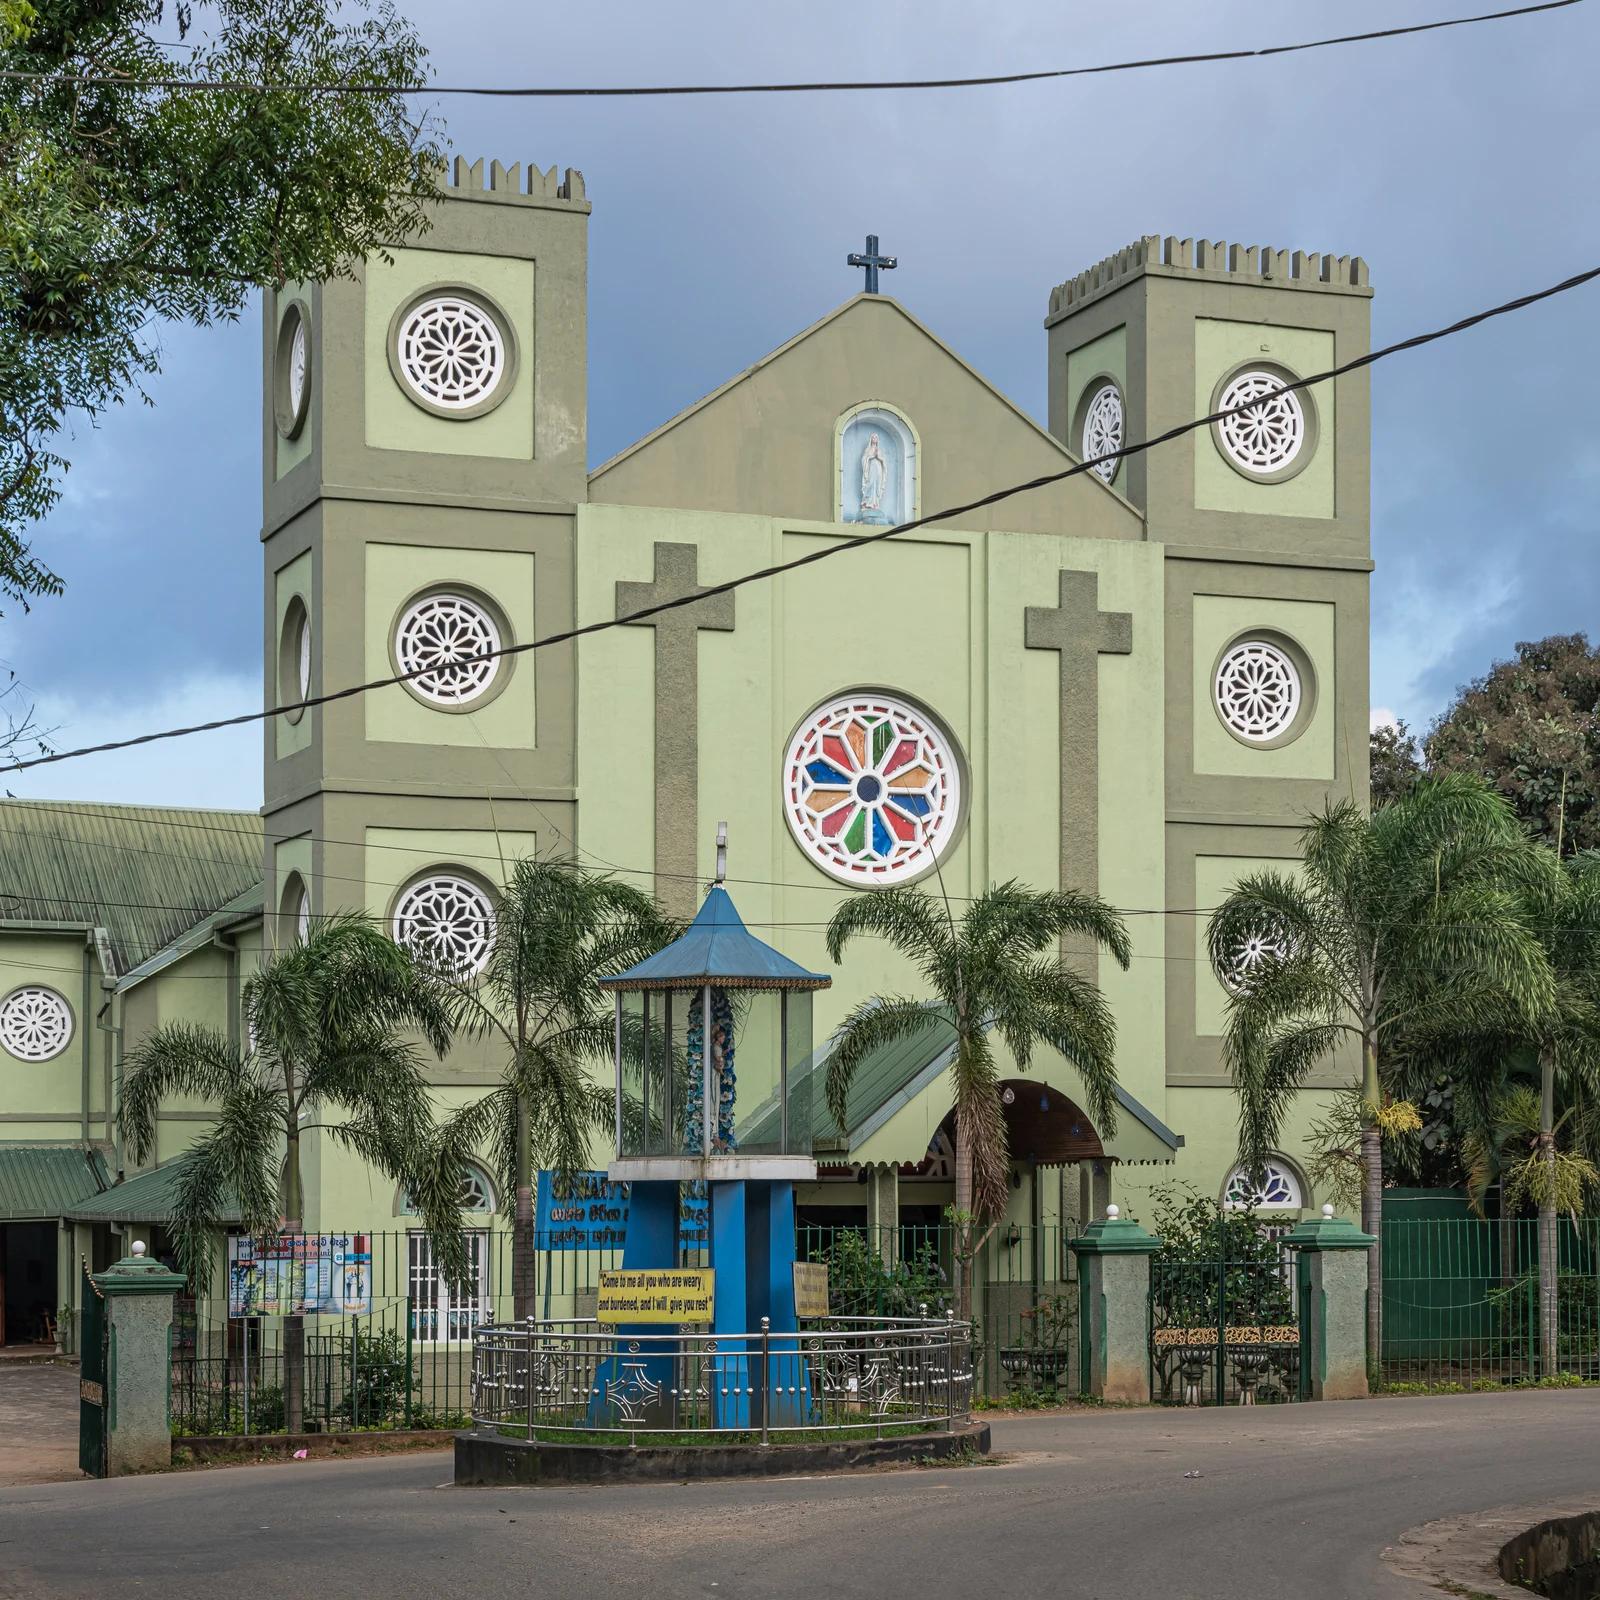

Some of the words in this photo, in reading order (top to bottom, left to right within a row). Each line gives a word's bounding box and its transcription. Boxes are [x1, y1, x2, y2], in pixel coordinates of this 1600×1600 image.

[619, 1274, 626, 1288] to
[627, 1276, 637, 1288] me
[637, 1273, 645, 1288] all
[646, 1276, 657, 1291] you
[658, 1273, 670, 1288] who
[671, 1277, 681, 1288] are
[598, 1296, 610, 1311] and
[610, 1296, 639, 1314] burdened,
[640, 1296, 652, 1311] and
[656, 1296, 668, 1311] will
[669, 1296, 682, 1315] give
[683, 1299, 695, 1315] you
